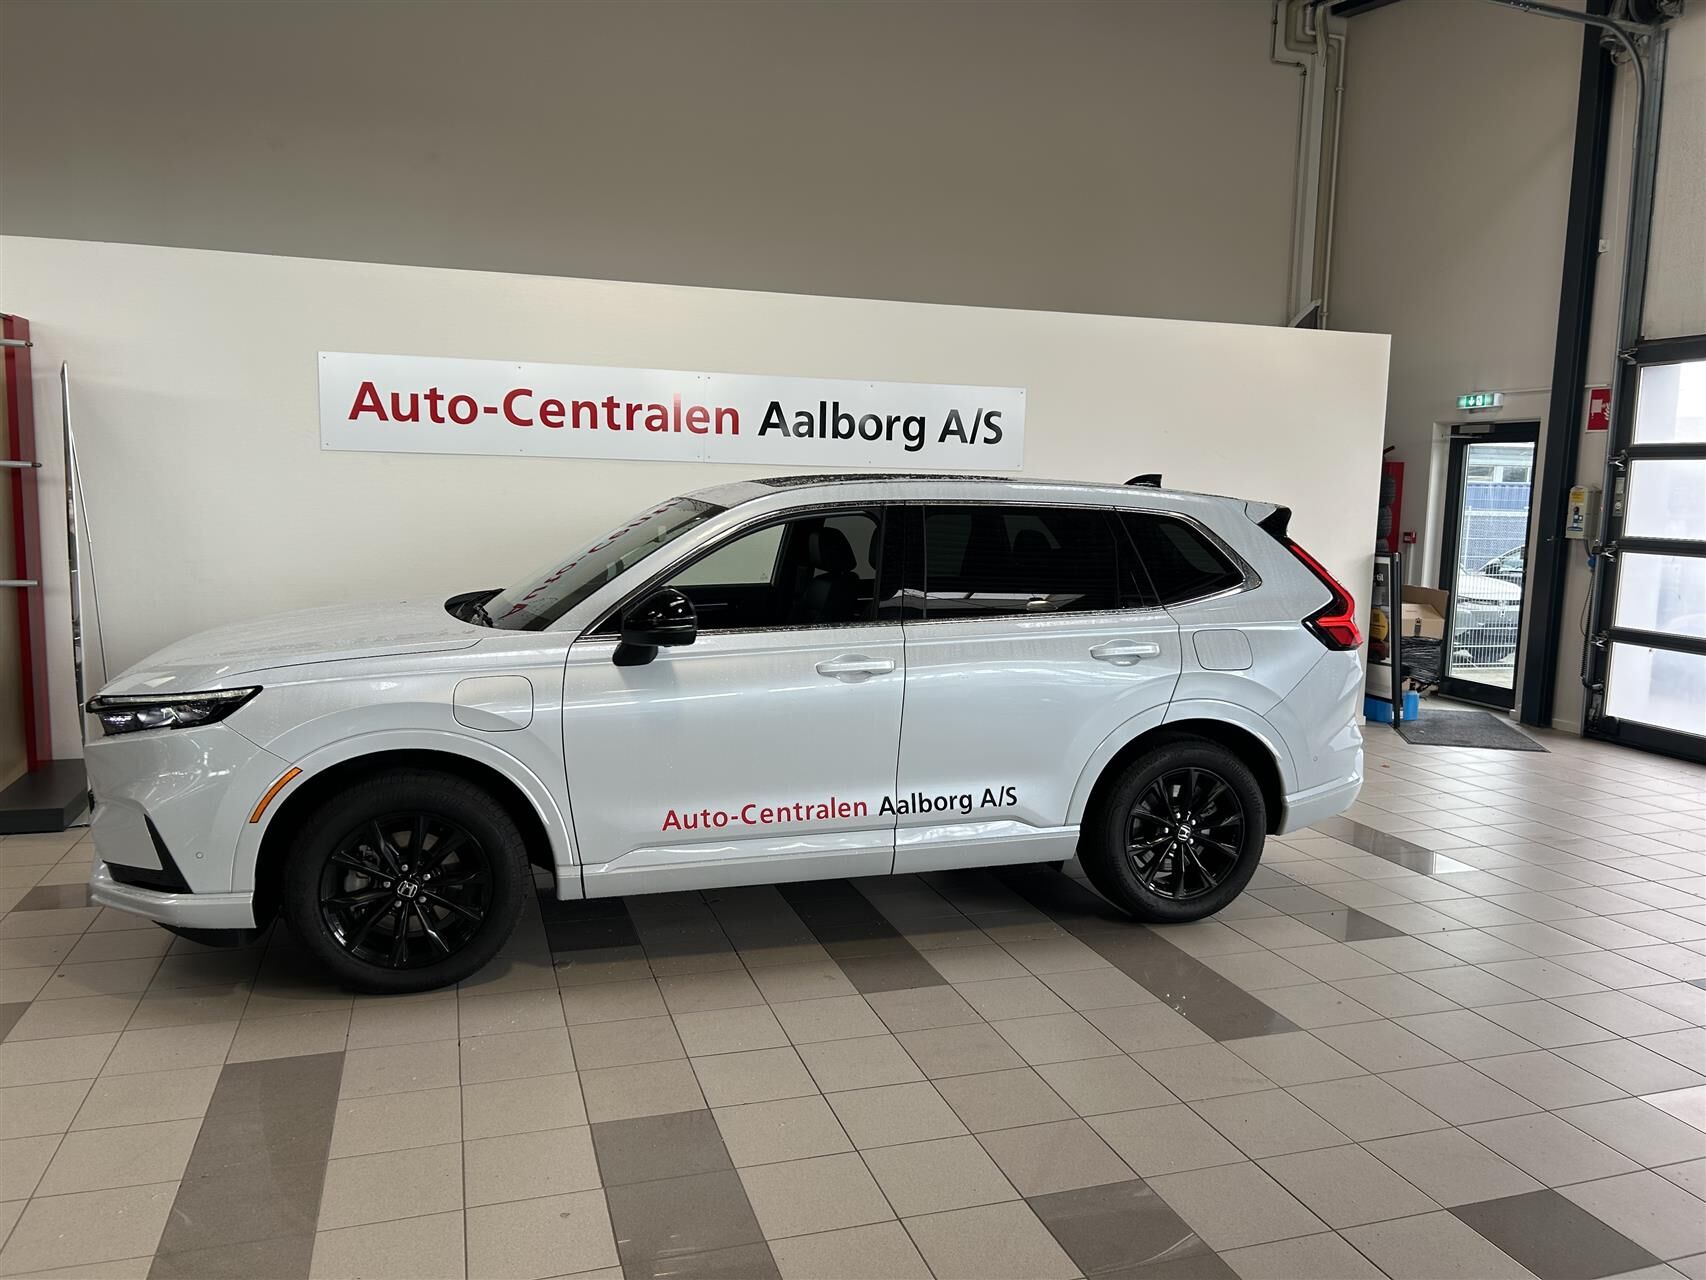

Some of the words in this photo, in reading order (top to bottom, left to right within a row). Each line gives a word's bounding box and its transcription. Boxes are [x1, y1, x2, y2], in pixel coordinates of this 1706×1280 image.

[348, 380, 740, 436] Auto-Centralen
[757, 399, 926, 452] Aalborg
[937, 408, 1003, 446] A/S
[661, 797, 868, 832] Auto-Centralen
[878, 792, 973, 815] Aalborg
[980, 785, 1018, 809] A/S
